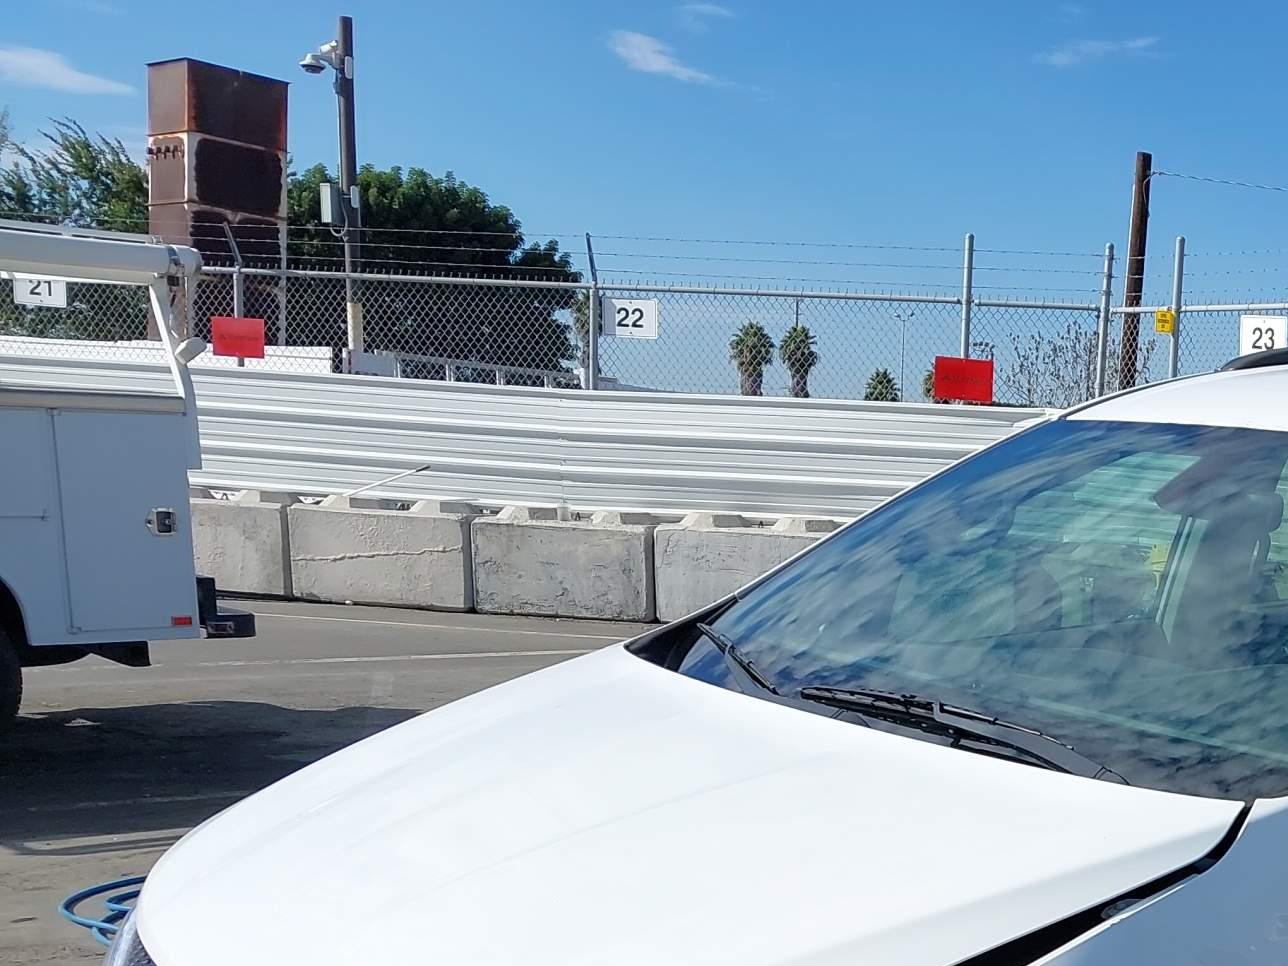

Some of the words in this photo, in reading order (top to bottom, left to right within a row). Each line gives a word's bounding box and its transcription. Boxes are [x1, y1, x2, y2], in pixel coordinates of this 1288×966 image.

[28, 280, 52, 297] 21
[616, 306, 644, 329] 22
[1251, 326, 1275, 350] 23
